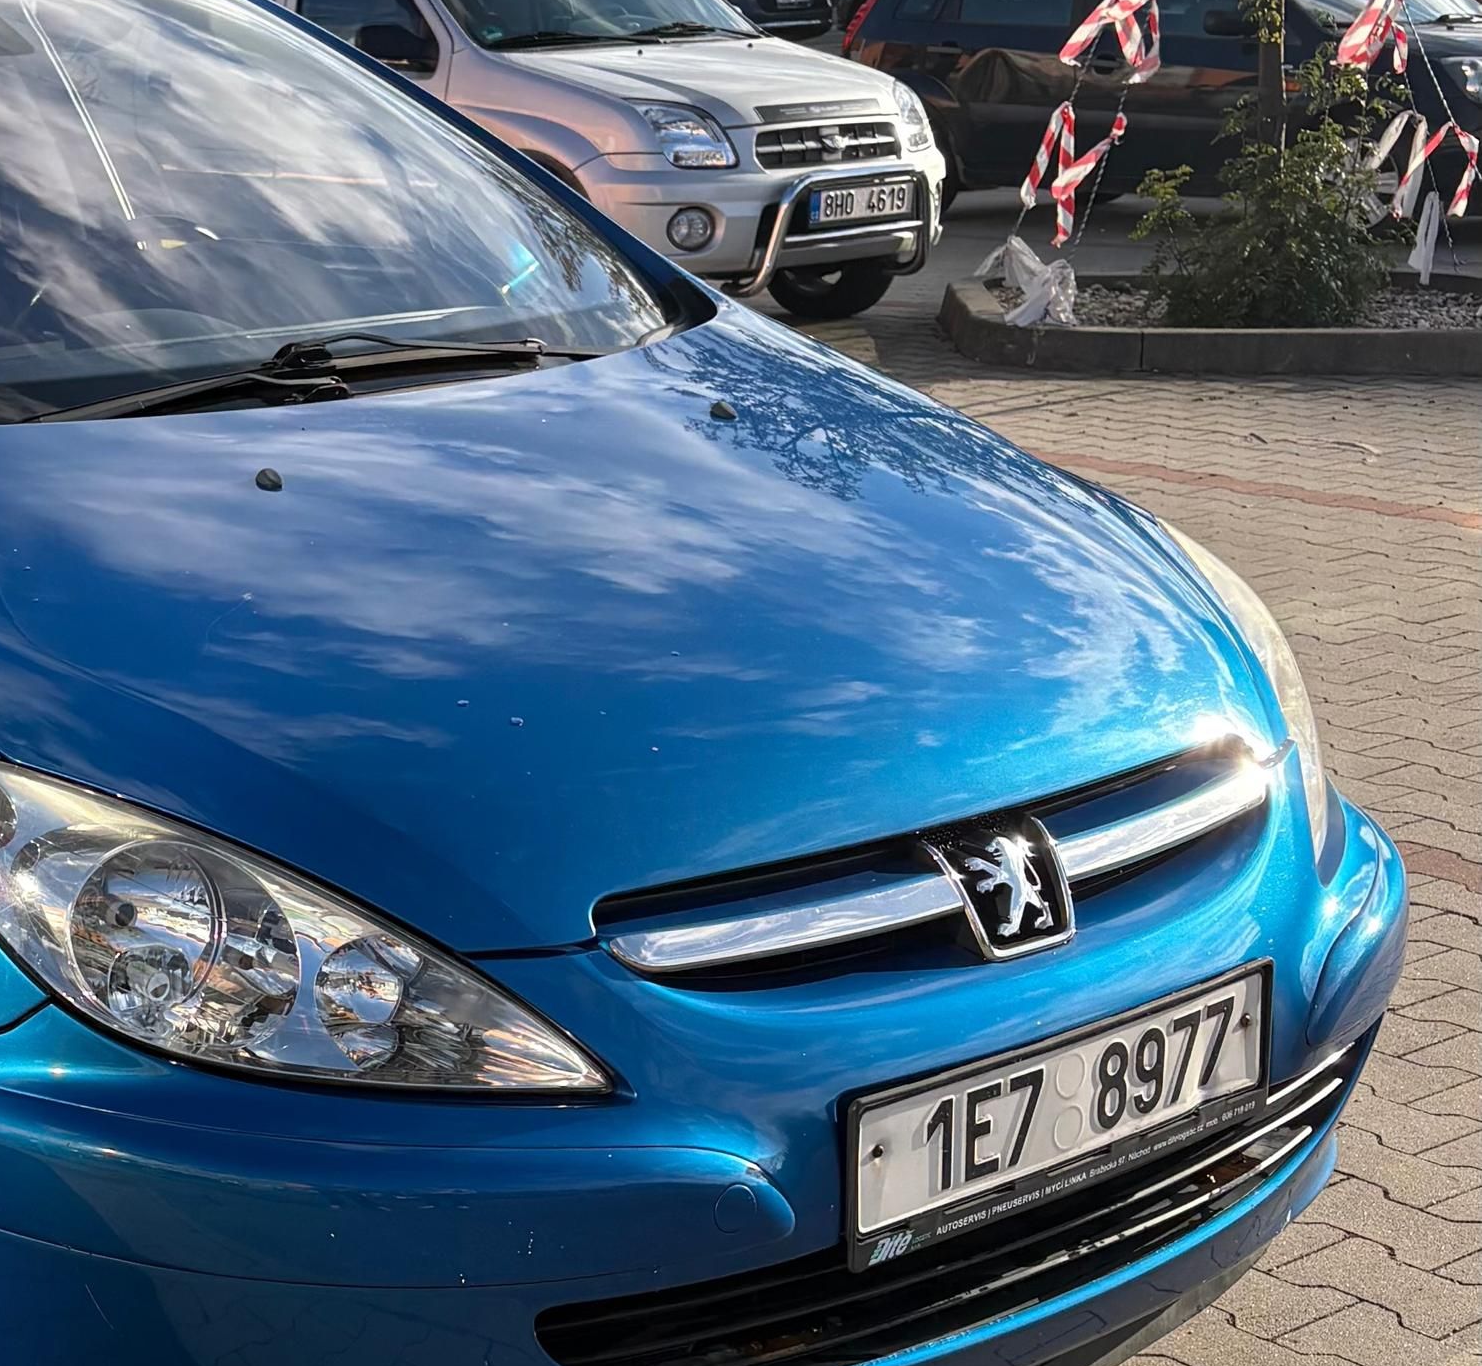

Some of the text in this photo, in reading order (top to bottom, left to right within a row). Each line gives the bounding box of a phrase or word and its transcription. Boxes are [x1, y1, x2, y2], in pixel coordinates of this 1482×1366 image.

[866, 186, 906, 214] 4619
[926, 995, 1236, 1190] 1E7 8977
[936, 1209, 988, 1236] AUTOSERVIS
[991, 1189, 1041, 1216] PNEUSERVIS
[1064, 1172, 1087, 1188] LINKA
